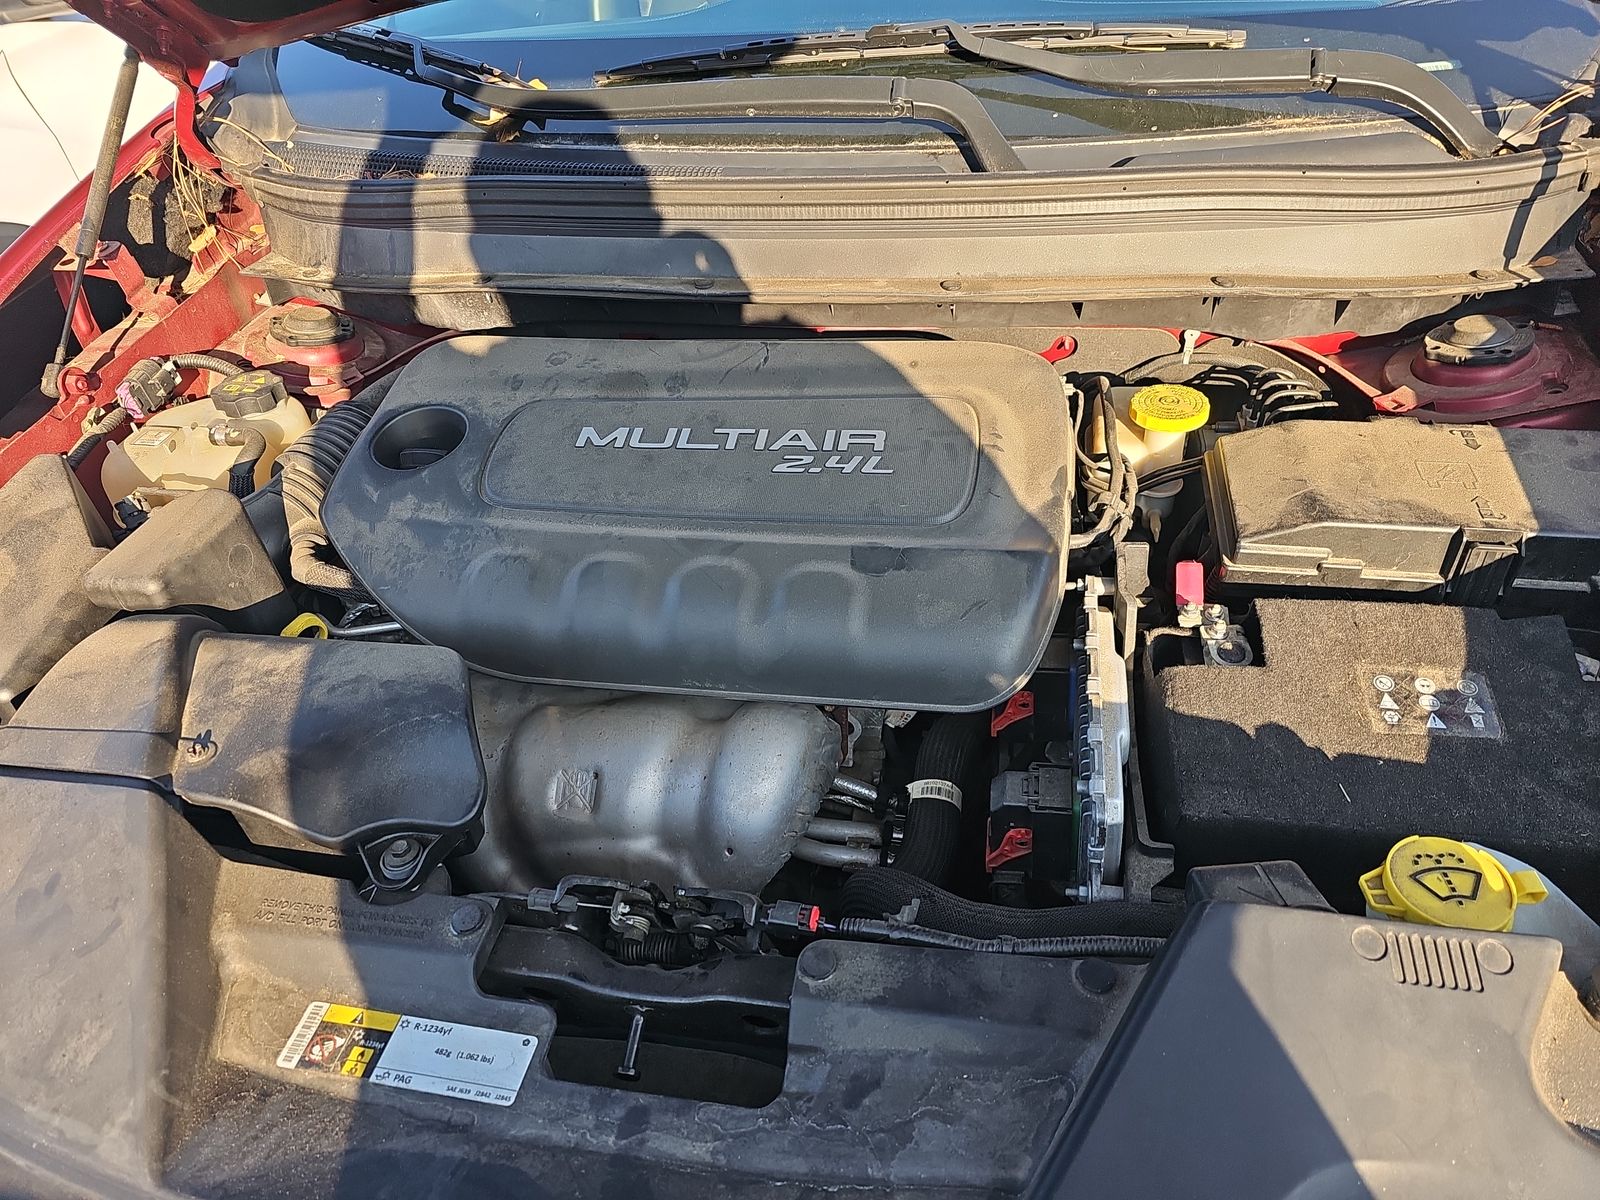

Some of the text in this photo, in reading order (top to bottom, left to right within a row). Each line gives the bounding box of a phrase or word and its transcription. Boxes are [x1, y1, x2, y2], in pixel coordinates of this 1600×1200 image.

[574, 426, 887, 452] MULTIAIR
[772, 454, 894, 475] 2.4L
[260, 898, 302, 911] REMOVE
[302, 902, 325, 913] THIS
[252, 910, 275, 921] A/C
[277, 912, 297, 924] FILL
[301, 915, 327, 927] PORT
[414, 1022, 453, 1036] R-1234yf
[434, 1047, 495, 1065] 482g (1.062 lbs)
[393, 1073, 413, 1085] PAG
[446, 1085, 457, 1093] SAE
